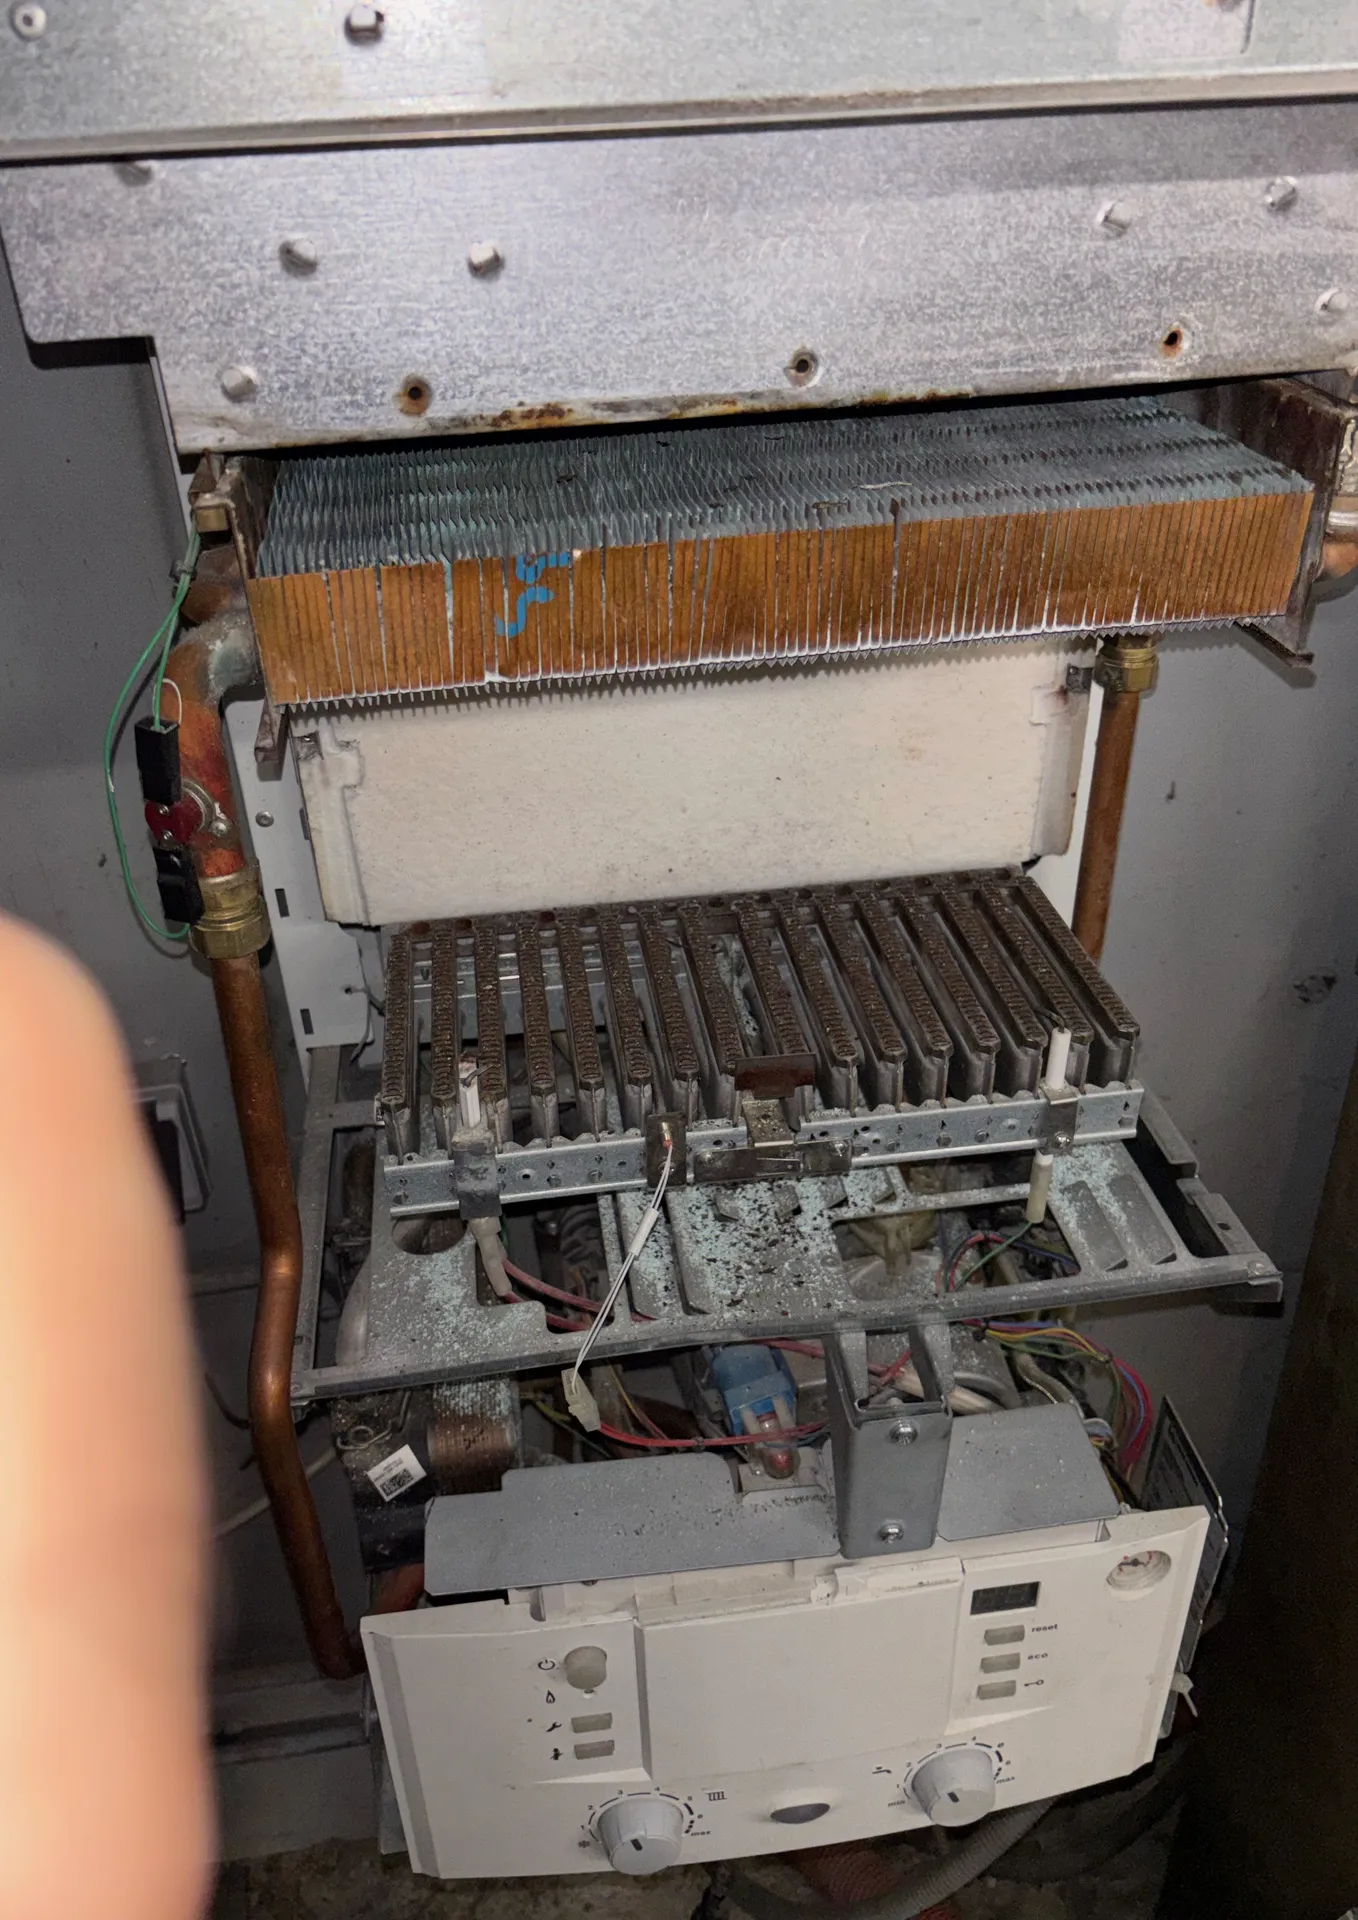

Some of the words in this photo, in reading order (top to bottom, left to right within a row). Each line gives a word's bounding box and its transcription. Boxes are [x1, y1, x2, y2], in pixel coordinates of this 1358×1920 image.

[1031, 1623, 1058, 1633] reset
[1027, 1652, 1048, 1661] eco
[996, 1776, 1015, 1784] max
